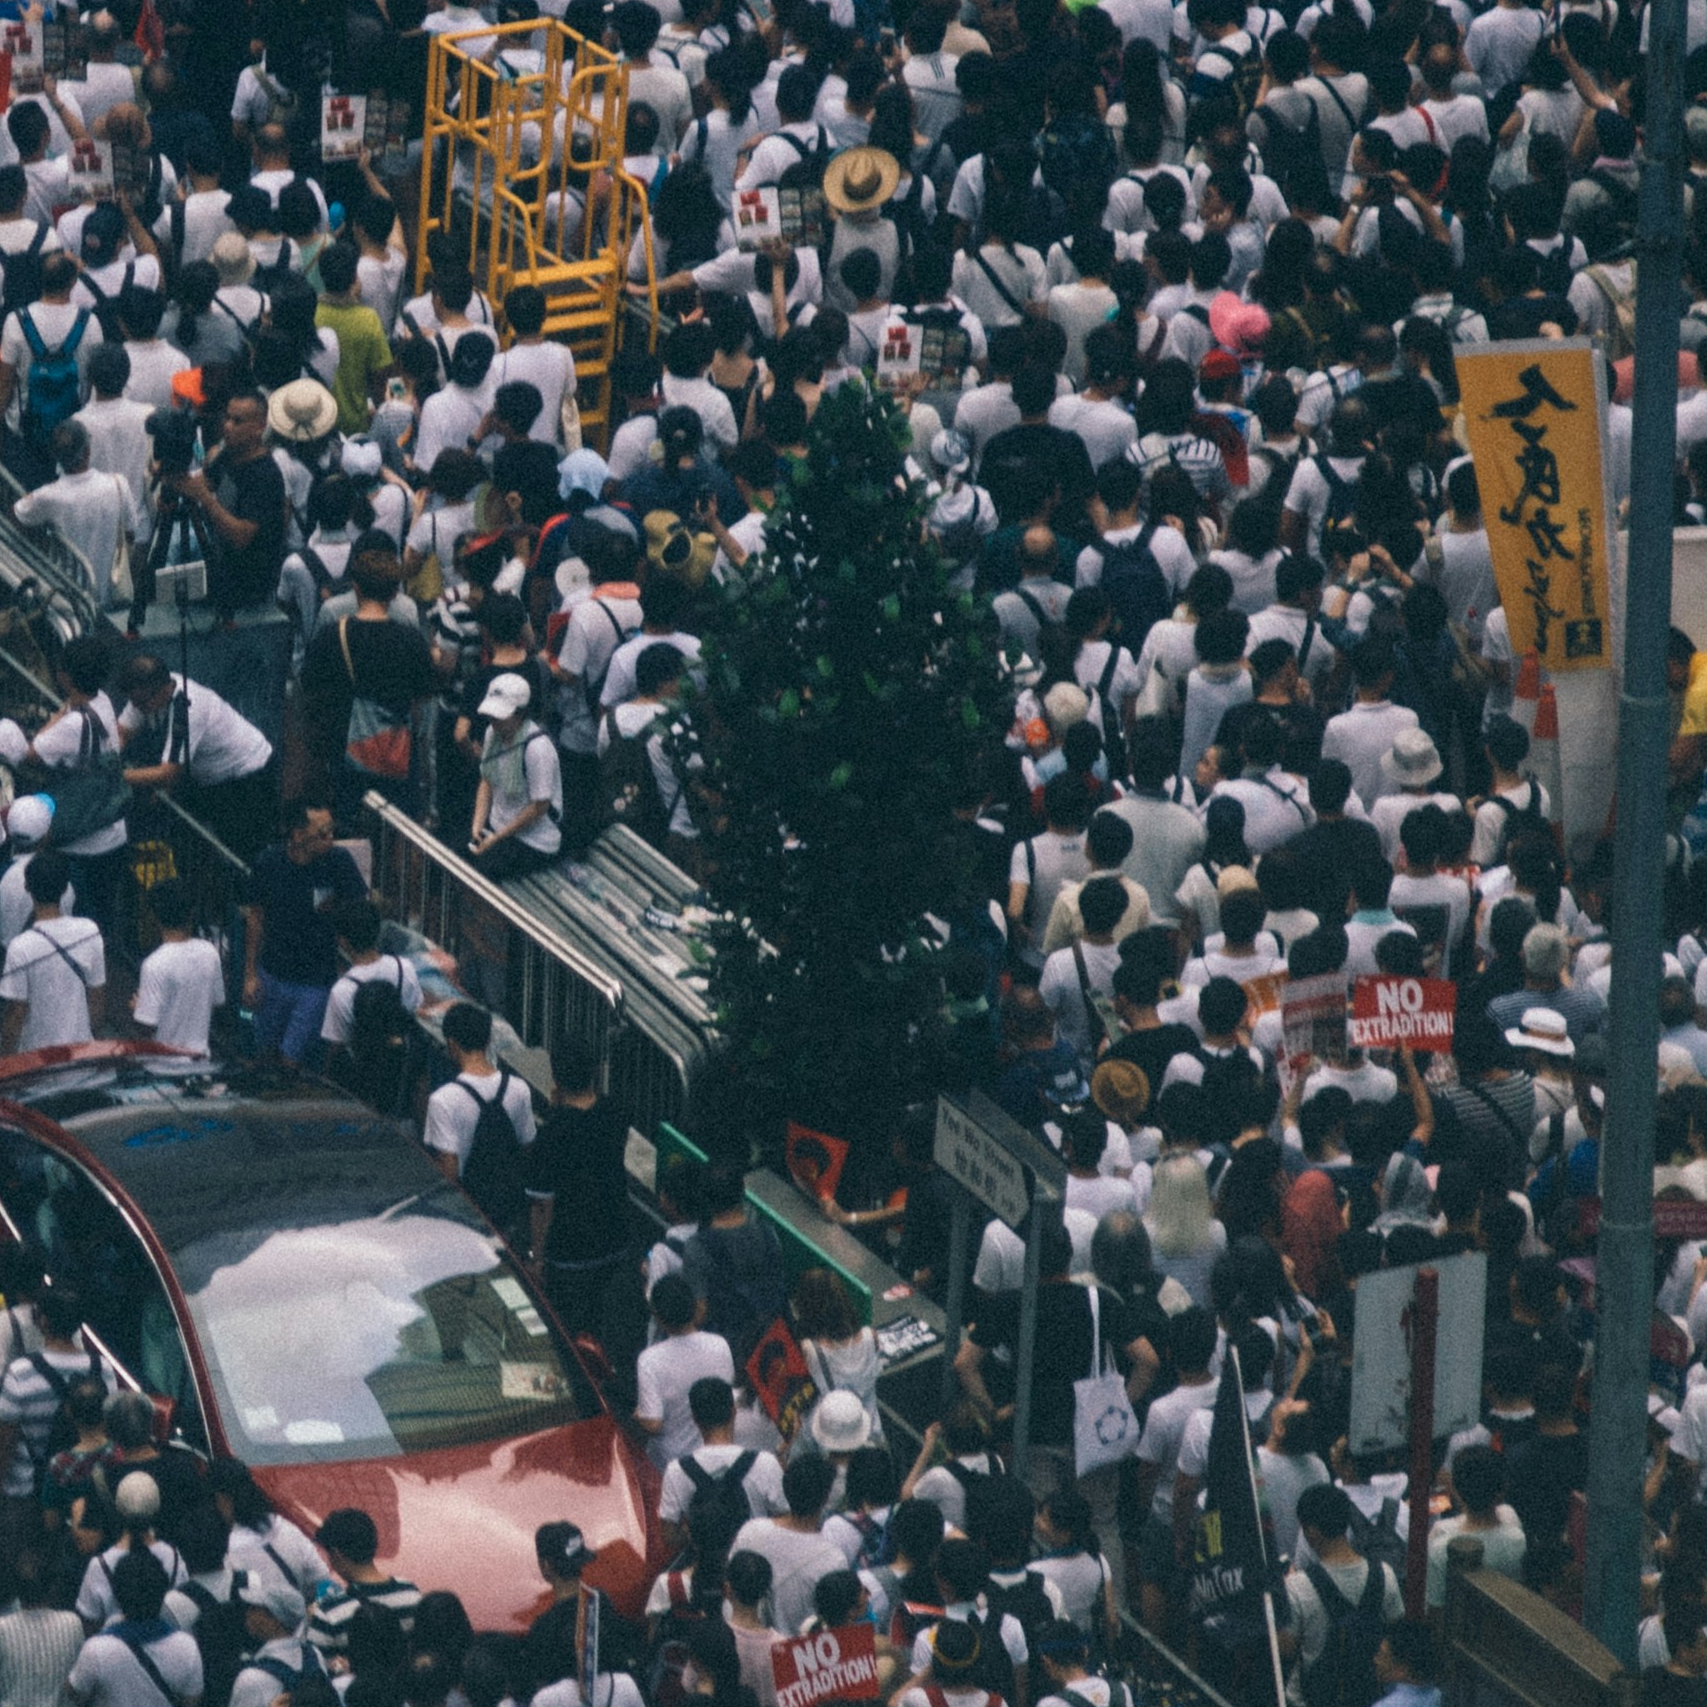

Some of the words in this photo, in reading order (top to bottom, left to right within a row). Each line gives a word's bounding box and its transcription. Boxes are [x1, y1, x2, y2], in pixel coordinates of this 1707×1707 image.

[1376, 978, 1424, 1014] NO
[1354, 1011, 1454, 1043] EXTRADITION!
[793, 1632, 841, 1681] NO
